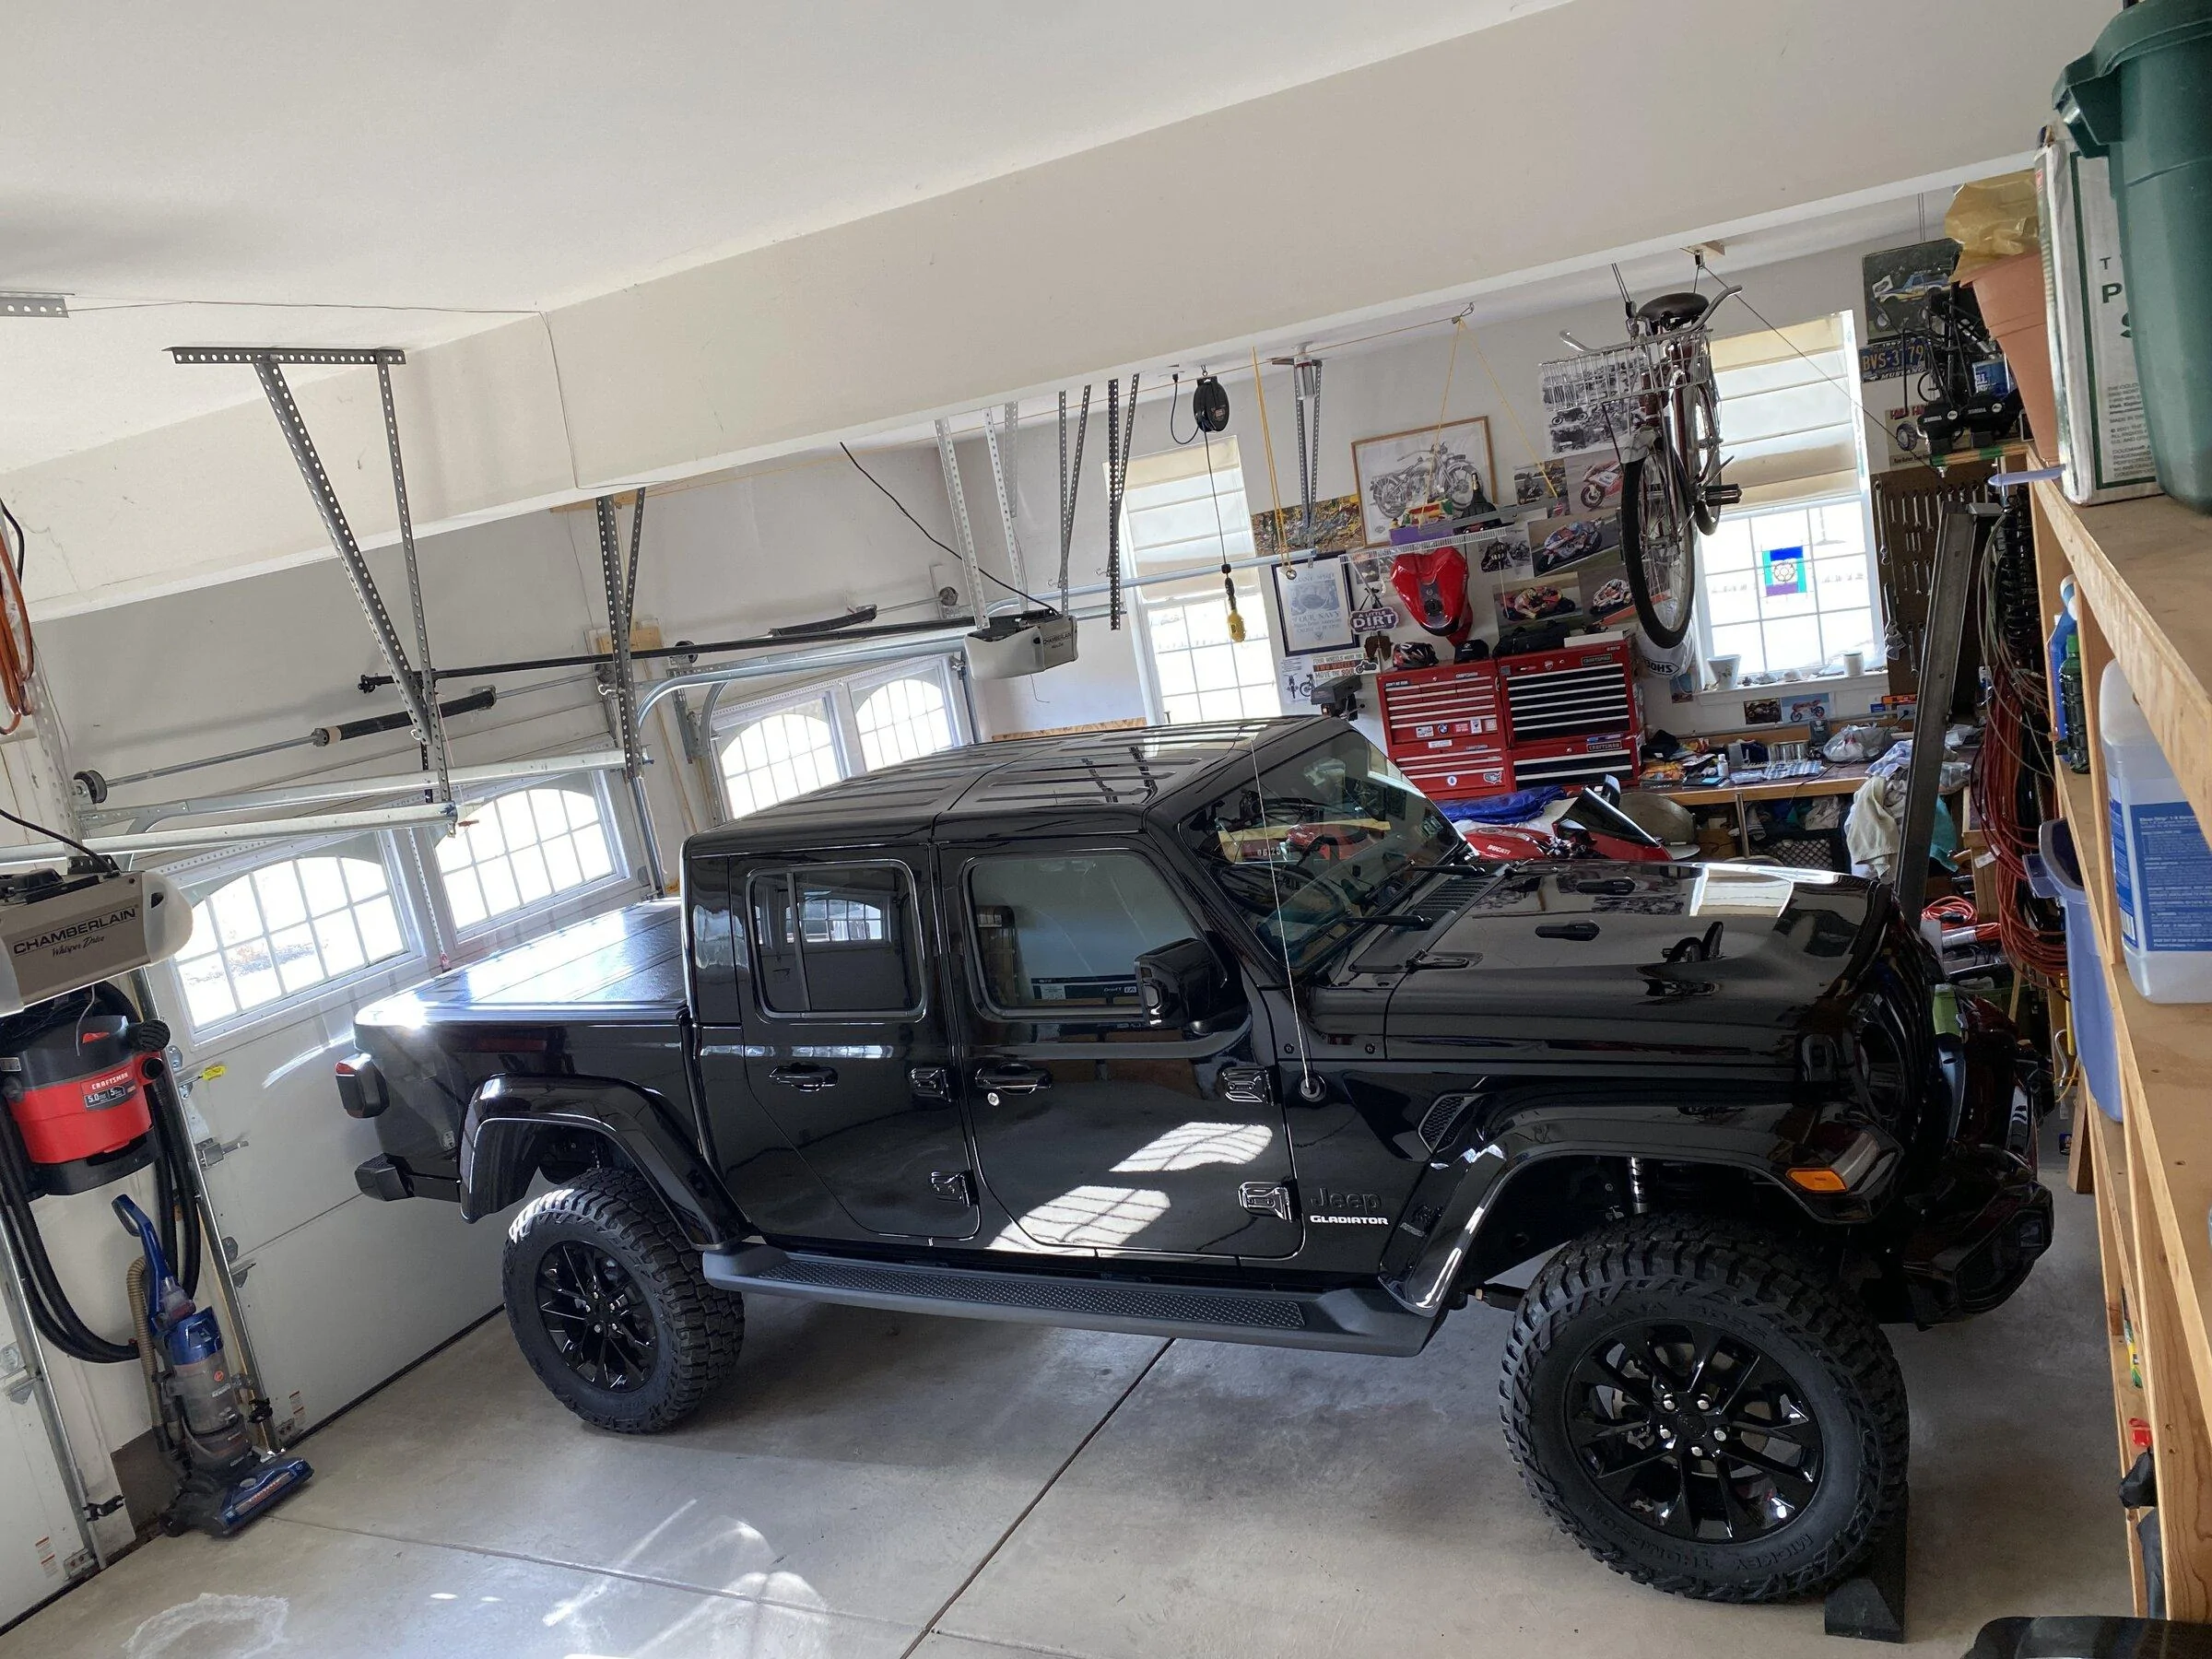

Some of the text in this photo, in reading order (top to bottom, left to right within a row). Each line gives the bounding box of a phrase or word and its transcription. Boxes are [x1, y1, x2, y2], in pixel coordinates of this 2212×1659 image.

[1353, 614, 1394, 628] DIRT
[1487, 844, 1512, 855] DUCATI
[13, 908, 135, 955] CHAMBERLAIN
[52, 935, 105, 958] Whisper Drive
[91, 1072, 128, 1089] CRAFTSMAN
[1310, 1187, 1382, 1215] Jeep
[1310, 1215, 1389, 1225] GLADIATOR
